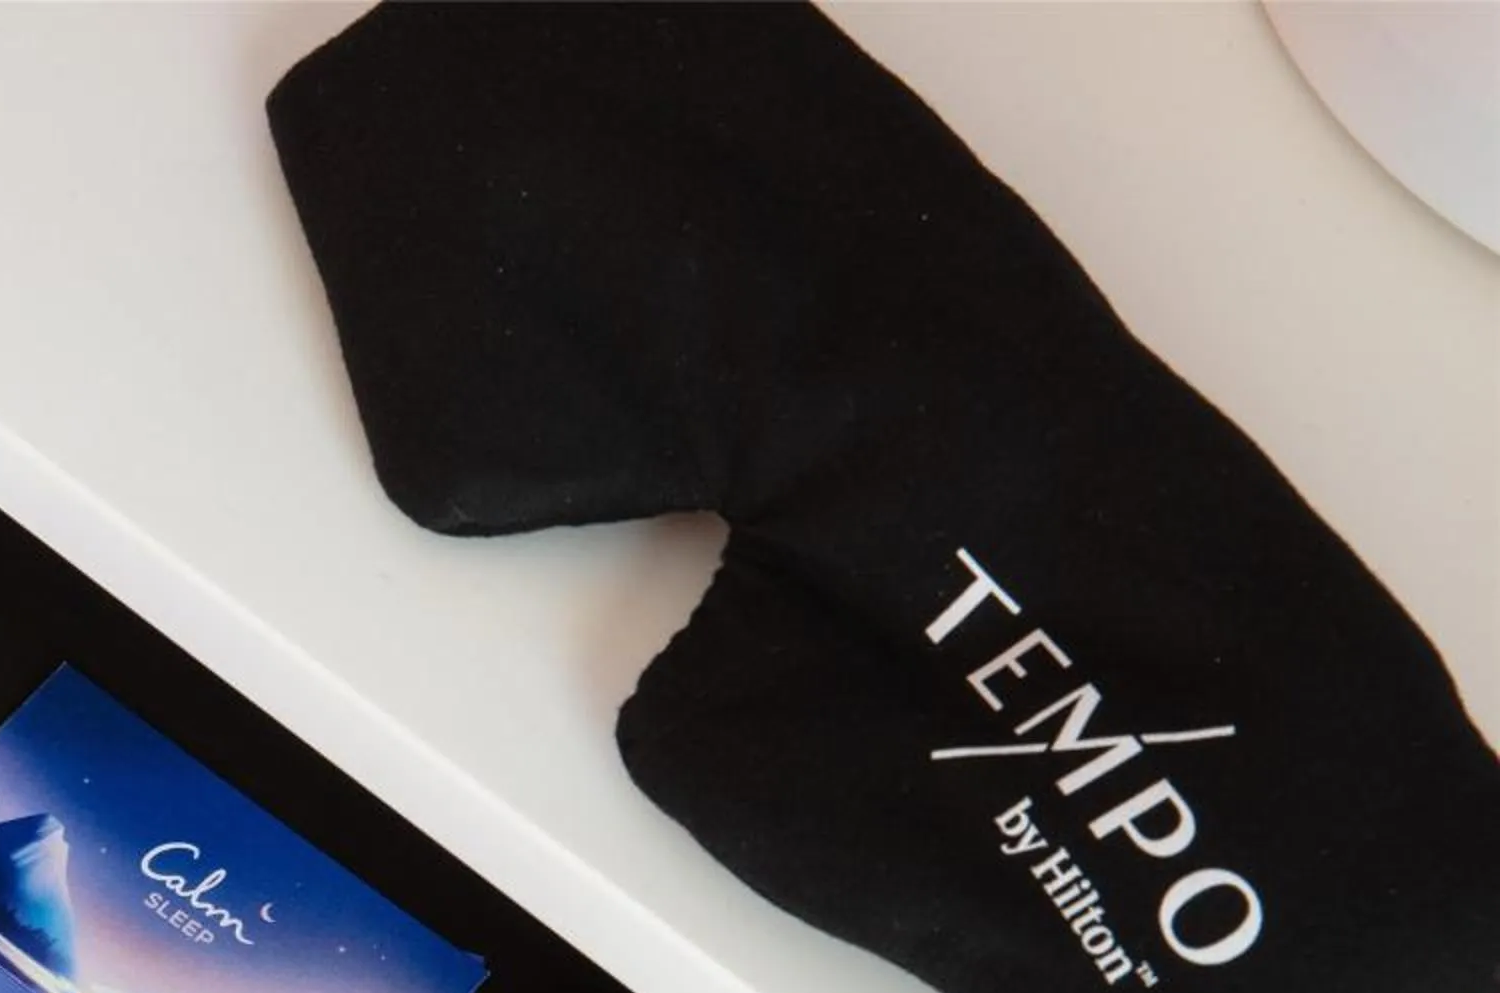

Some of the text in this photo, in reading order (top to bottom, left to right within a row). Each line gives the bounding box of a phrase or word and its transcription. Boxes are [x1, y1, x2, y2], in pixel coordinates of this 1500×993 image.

[924, 547, 1263, 966] TEMPO
[993, 796, 1048, 856] by
[141, 841, 255, 945] Calm
[144, 892, 215, 944] SLEEP
